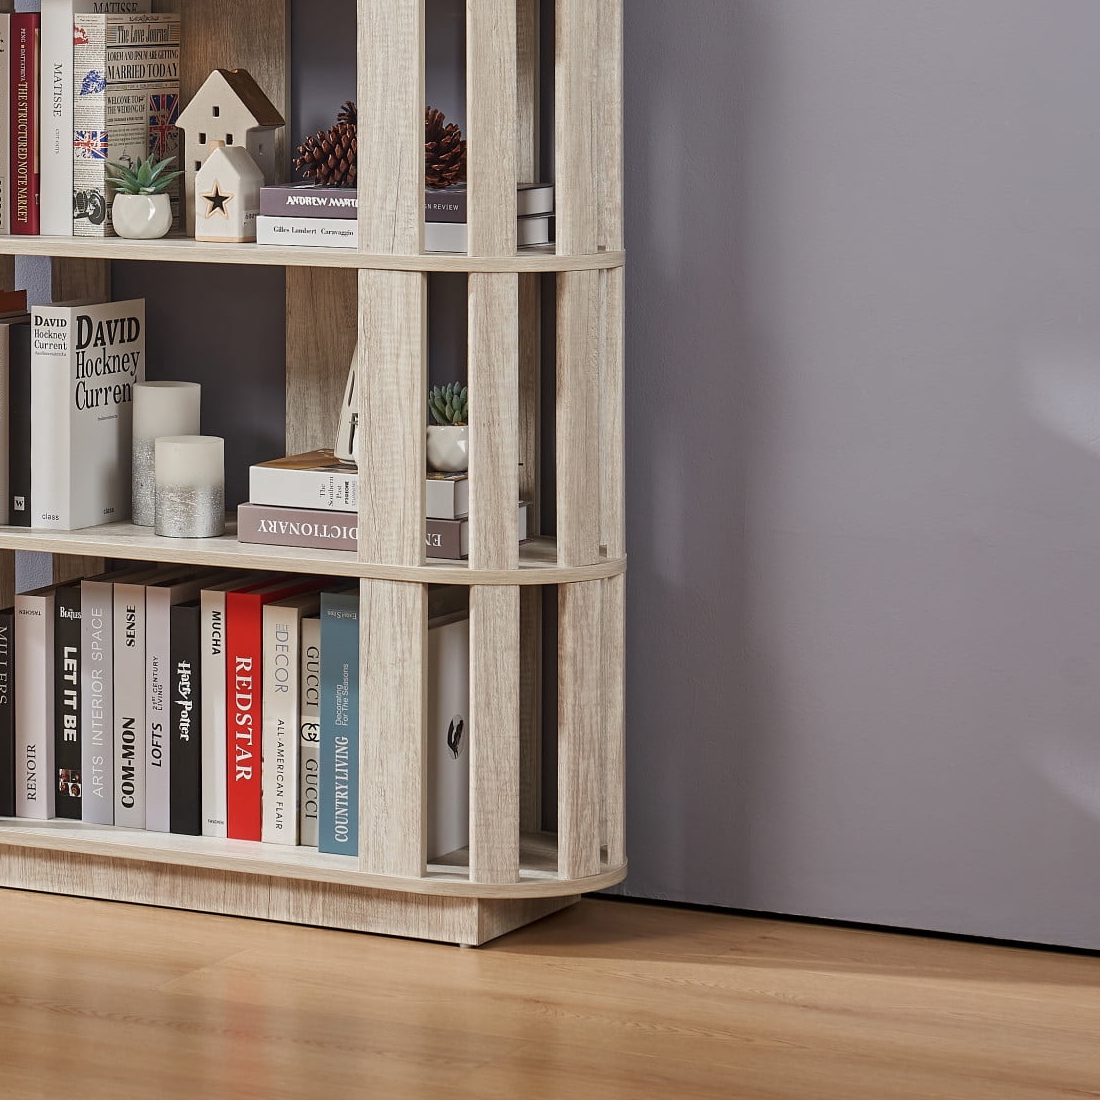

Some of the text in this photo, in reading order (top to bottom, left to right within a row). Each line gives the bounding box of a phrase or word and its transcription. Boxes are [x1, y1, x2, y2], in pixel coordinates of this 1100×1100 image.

[117, 24, 170, 43] The Love Journal
[107, 49, 179, 61] LOREM AND IPSUM ARE GETTING
[107, 63, 178, 80] MARRIED TODAY
[17, 82, 28, 101] THE
[53, 63, 63, 117] MATISSE
[107, 106, 116, 114] THE
[17, 101, 28, 160] STRUCTURED
[17, 161, 28, 186] NOTE
[285, 195, 358, 208] ANDREW MART
[433, 203, 459, 211] REVIEW
[273, 225, 290, 233] Gilles
[291, 226, 317, 235] Lambert
[34, 315, 67, 327] DAVID
[34, 329, 67, 341] Hockney
[75, 314, 141, 350] DAVID
[34, 339, 68, 351] Current
[75, 347, 141, 380] Hockney
[75, 375, 137, 411] Curren
[41, 512, 60, 521] class
[257, 518, 359, 541] DICTIONARY
[125, 604, 136, 648] SENSE
[211, 610, 222, 655] MUCHA
[275, 630, 289, 693] DECOR
[306, 646, 319, 707] GUCCI
[63, 646, 77, 742] LET IT BE
[91, 607, 104, 798] ARTS INTERIOR SPACE
[341, 663, 349, 726] For The Seasons
[174, 700, 194, 742] Potter
[235, 655, 253, 781] REDSTAR
[121, 716, 136, 809] COM-MON
[151, 722, 163, 768] LOFTS
[26, 744, 37, 801] RENOIR
[275, 719, 285, 830] ALL-AMERICAN FLAIR
[305, 758, 319, 820] GUCCI
[334, 735, 349, 843] COUNTRY LIVING
